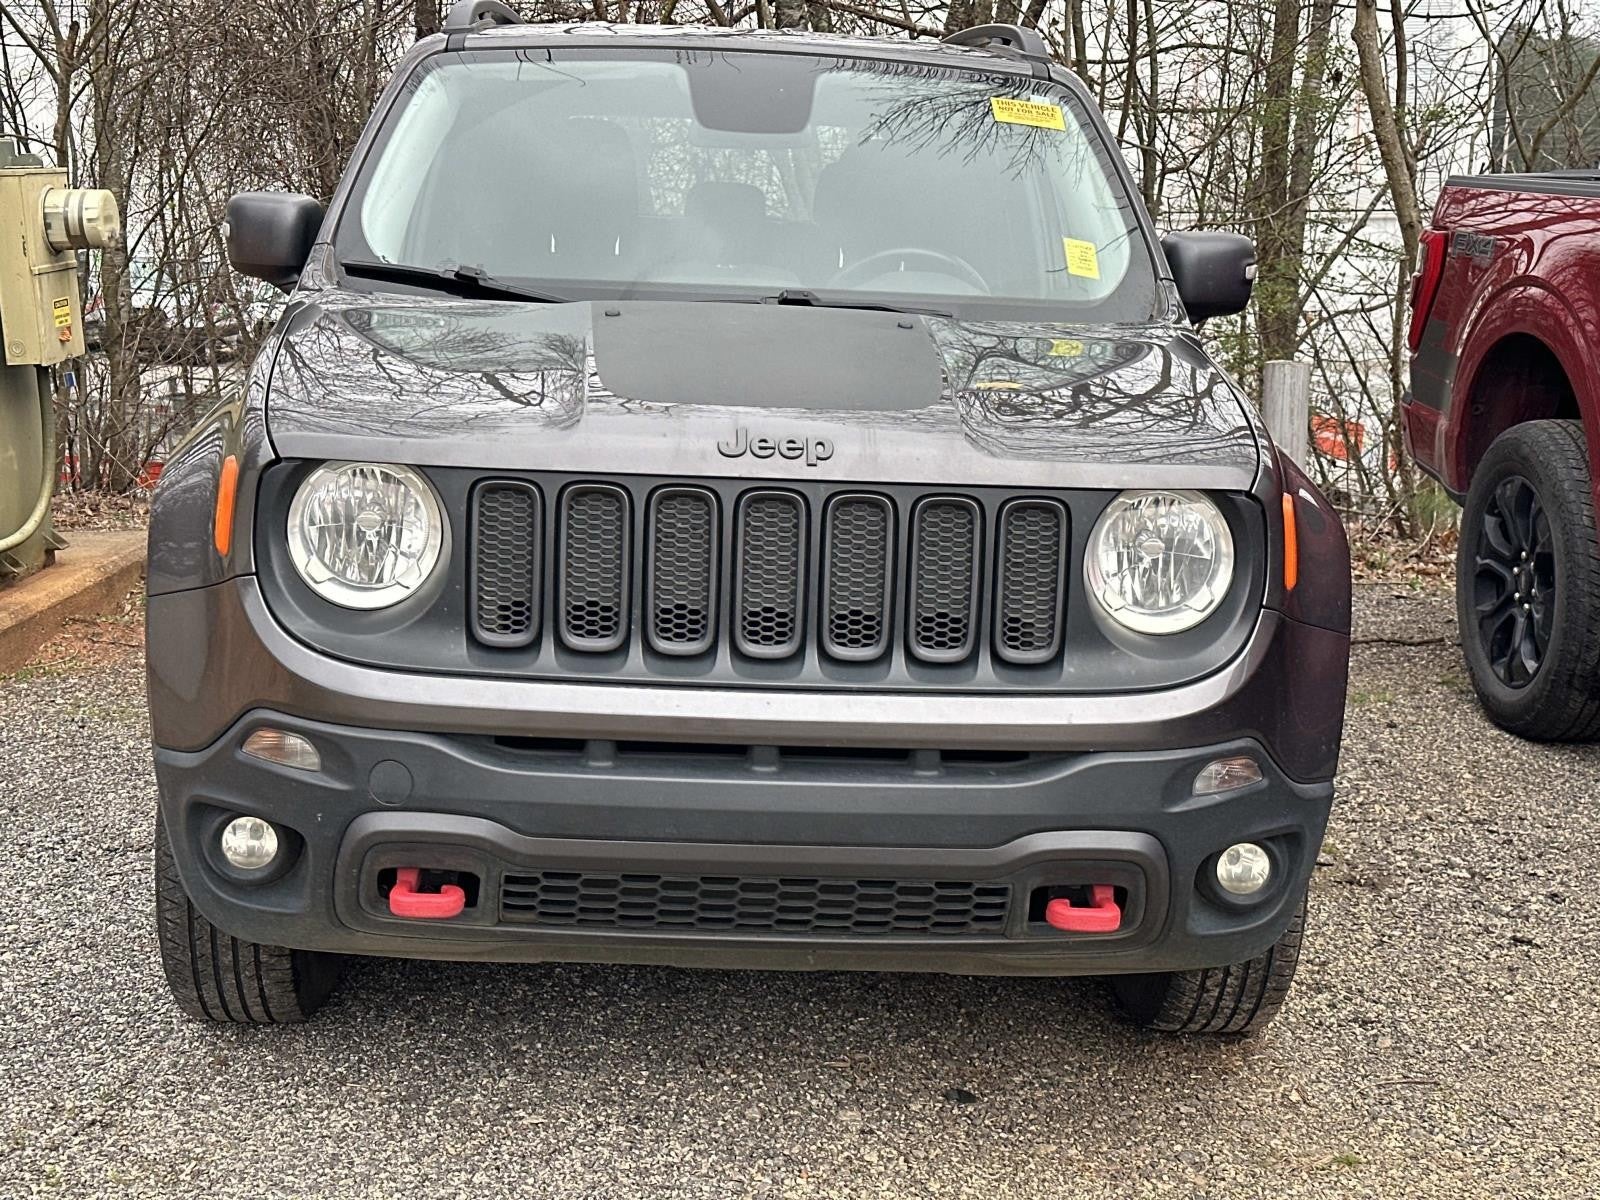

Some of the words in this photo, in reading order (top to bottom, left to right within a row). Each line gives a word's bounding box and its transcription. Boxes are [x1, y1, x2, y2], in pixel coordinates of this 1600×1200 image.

[1018, 102, 1057, 113] VEHICLE
[1035, 110, 1056, 118] SALE
[1452, 230, 1496, 259] FX4
[717, 427, 835, 467] Jeep
